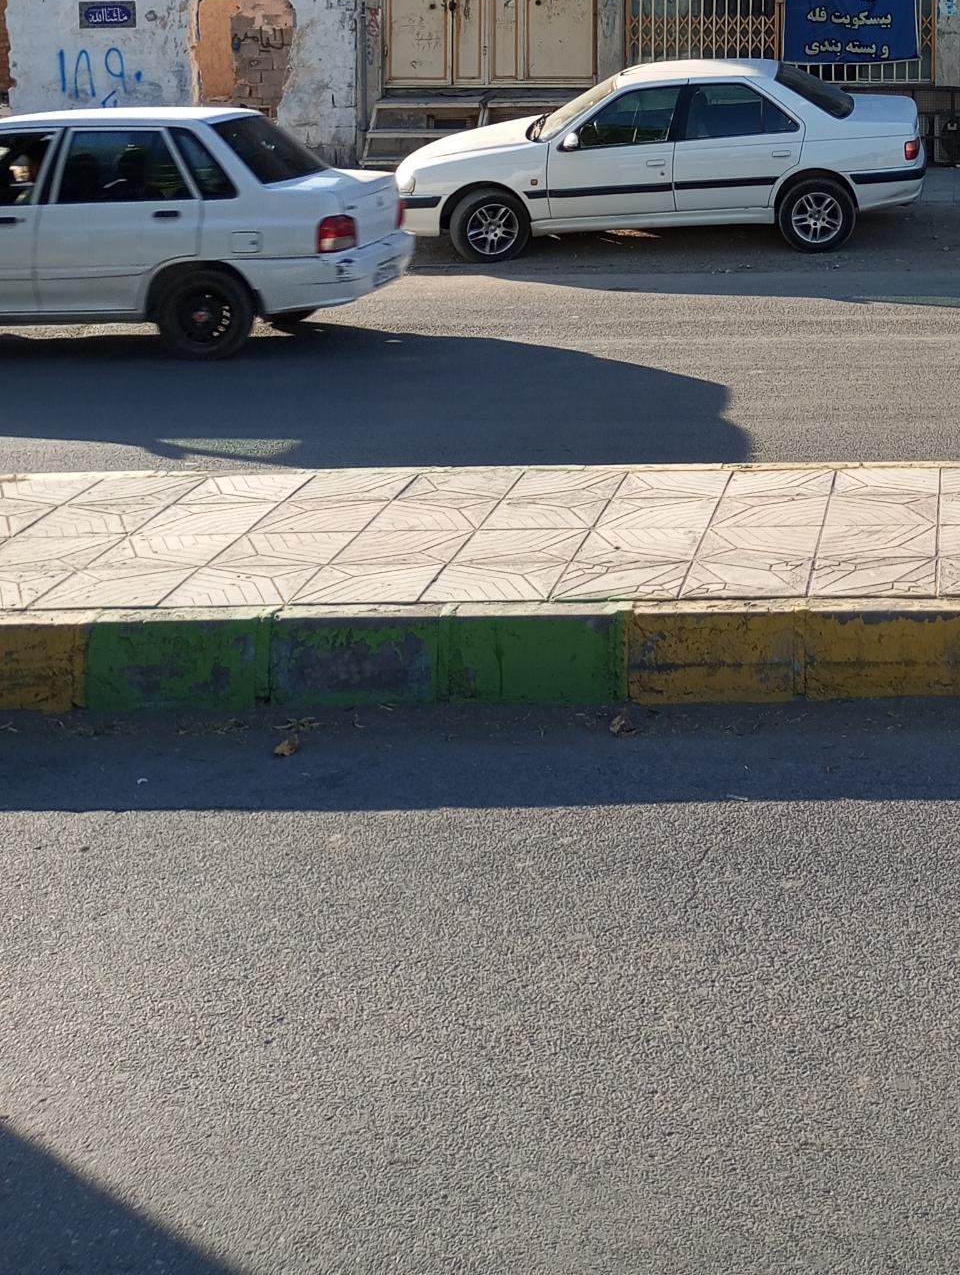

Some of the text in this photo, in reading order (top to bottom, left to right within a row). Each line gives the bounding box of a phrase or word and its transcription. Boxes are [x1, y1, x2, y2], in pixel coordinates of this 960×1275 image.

[806, 7, 892, 29] بیسکویت فله
[805, 39, 890, 59] و بسته بندی
